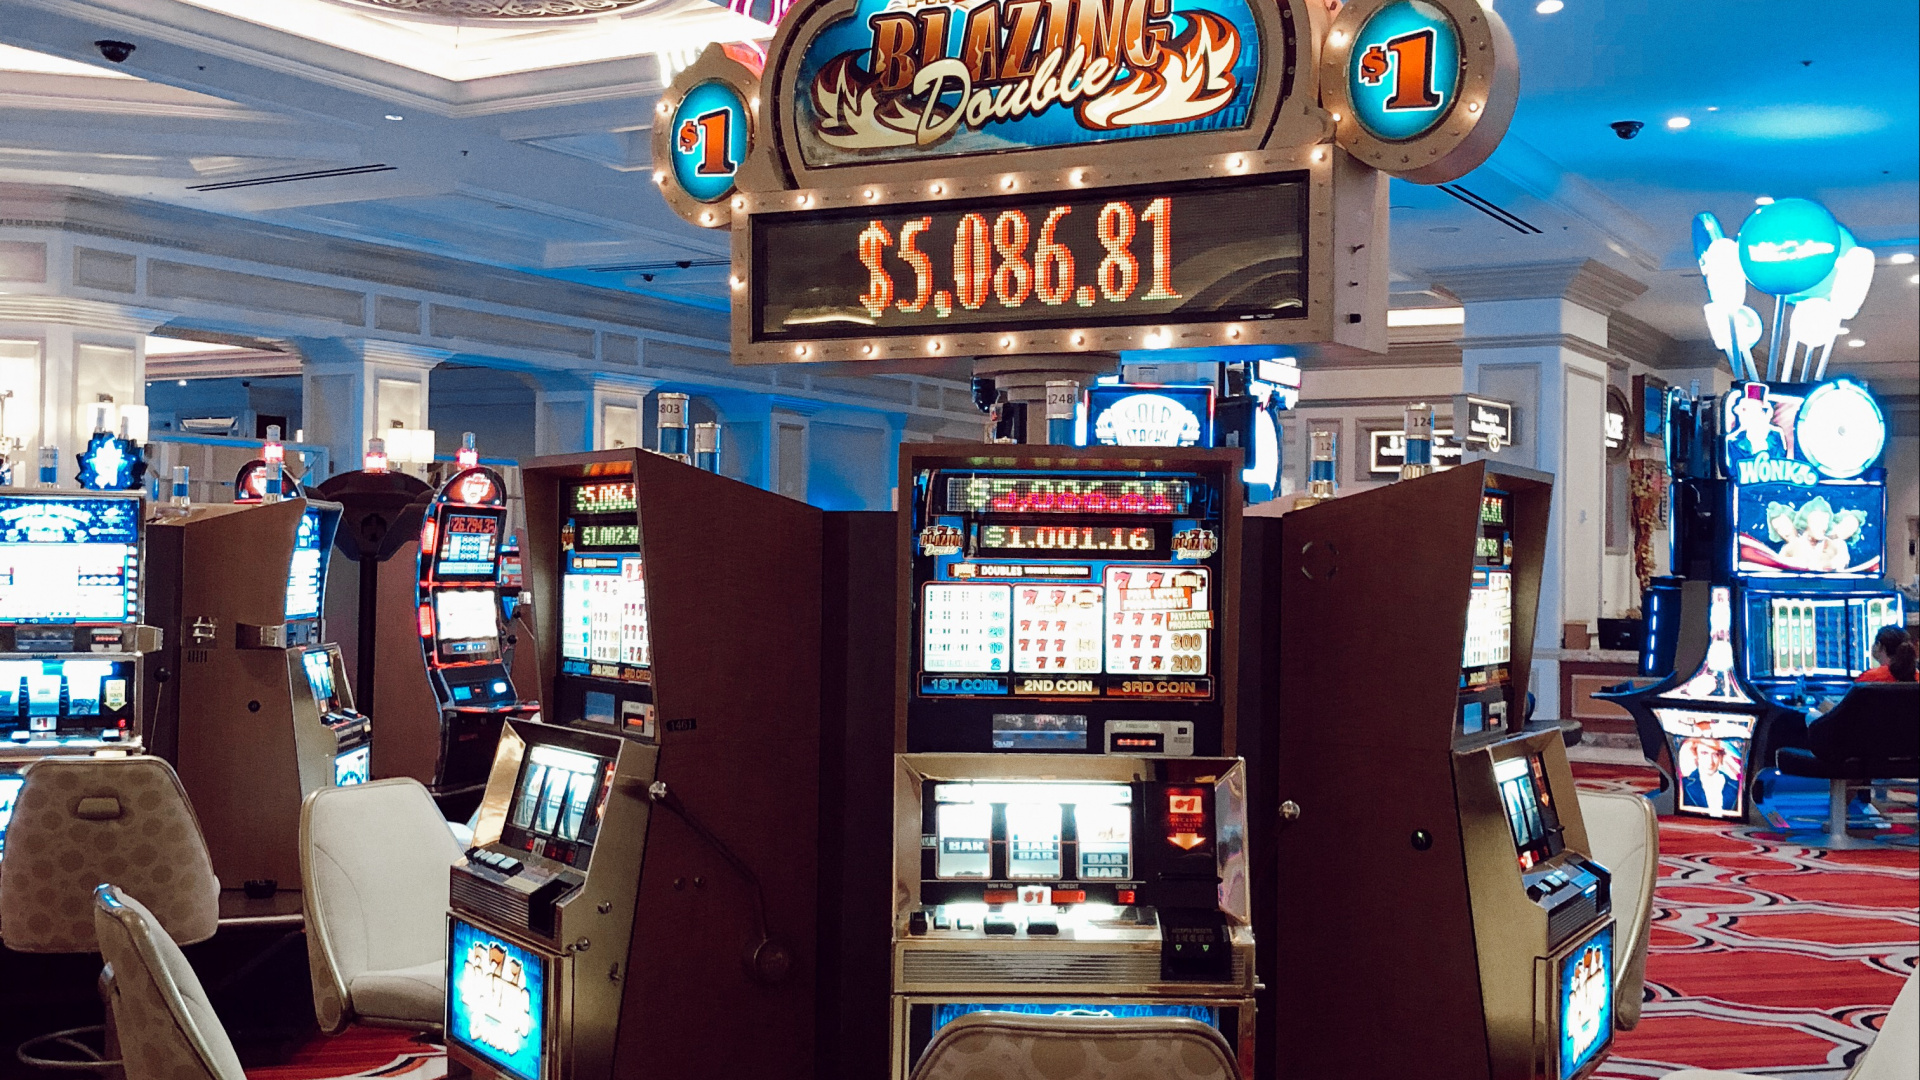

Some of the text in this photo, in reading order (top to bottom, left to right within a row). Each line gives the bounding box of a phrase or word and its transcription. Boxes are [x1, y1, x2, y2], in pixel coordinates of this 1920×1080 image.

[872, 0, 1171, 92] BLAZING
[1359, 27, 1443, 111] $1
[913, 32, 1119, 147] Double
[679, 107, 737, 177] $1
[858, 197, 1183, 318] $5,086.81
[1738, 451, 1818, 486] WONKA
[981, 566, 1023, 576] DOUBLES
[1188, 611, 1210, 620] LOWER
[1169, 620, 1212, 630] PROGRESSIVE
[1170, 632, 1203, 651] 300
[990, 657, 1002, 671] 2
[1170, 654, 1203, 673] 200
[931, 679, 999, 692] 1ST COIN
[1024, 679, 1093, 692] 2ND COIN
[1122, 681, 1196, 694] 3RD COIN
[1087, 854, 1123, 865] BAR
[1087, 867, 1123, 878] BAR
[1023, 890, 1045, 904] $1
[1127, 890, 1135, 903] 3
